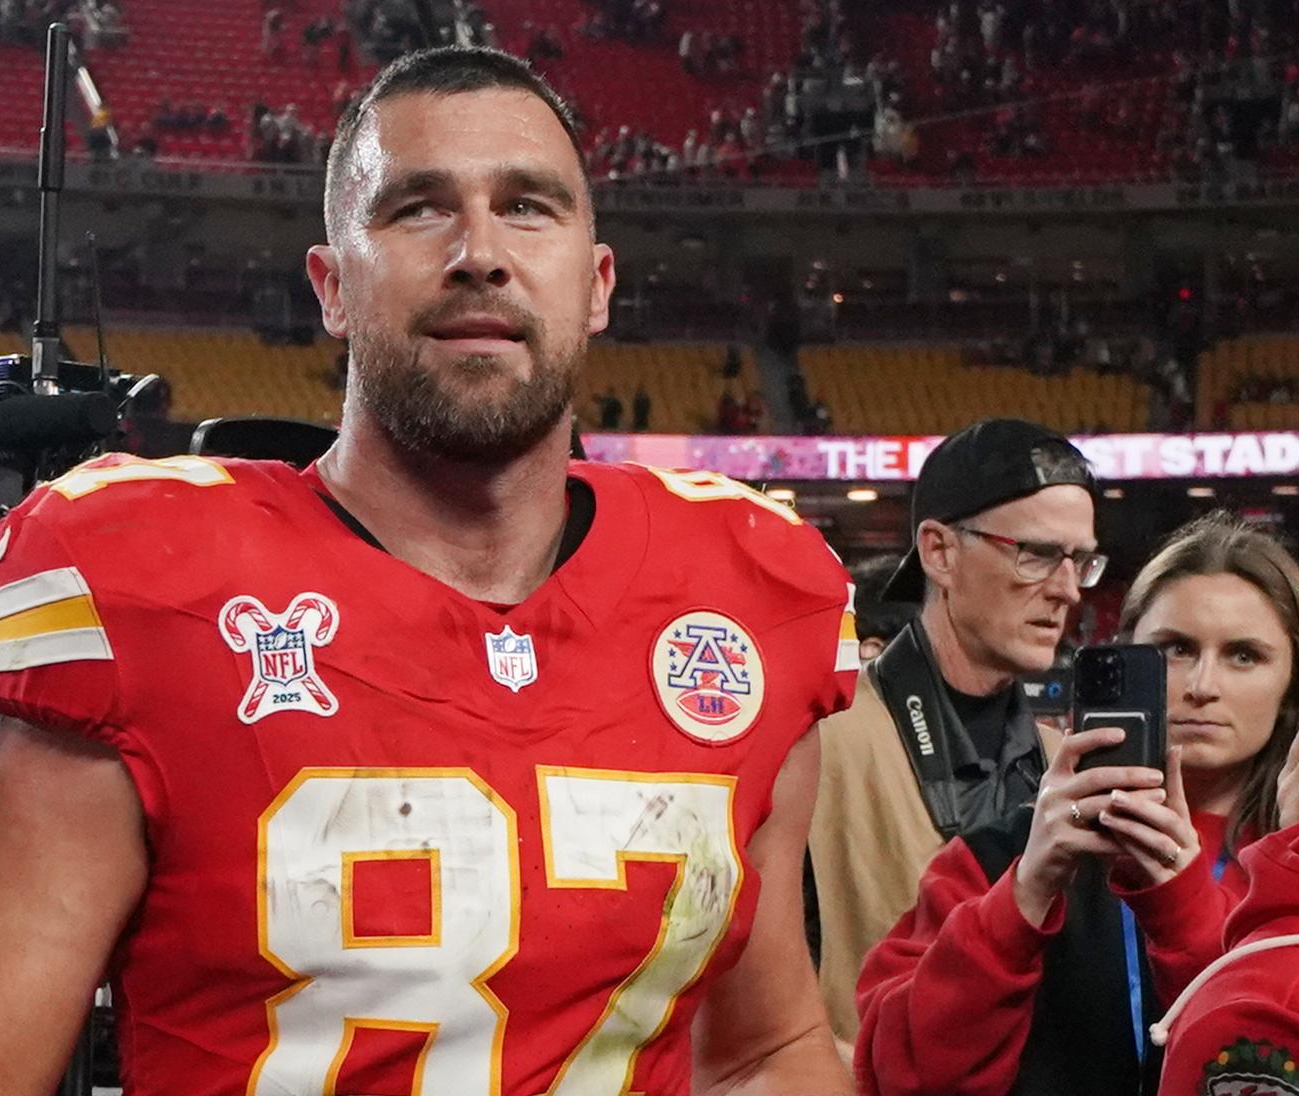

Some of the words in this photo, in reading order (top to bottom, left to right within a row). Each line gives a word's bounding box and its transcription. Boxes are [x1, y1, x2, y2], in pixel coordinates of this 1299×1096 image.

[819, 442, 903, 479] THE
[261, 652, 303, 679] NFL
[496, 655, 529, 678] NFL
[272, 693, 301, 705] 2025
[906, 694, 935, 755] Canon
